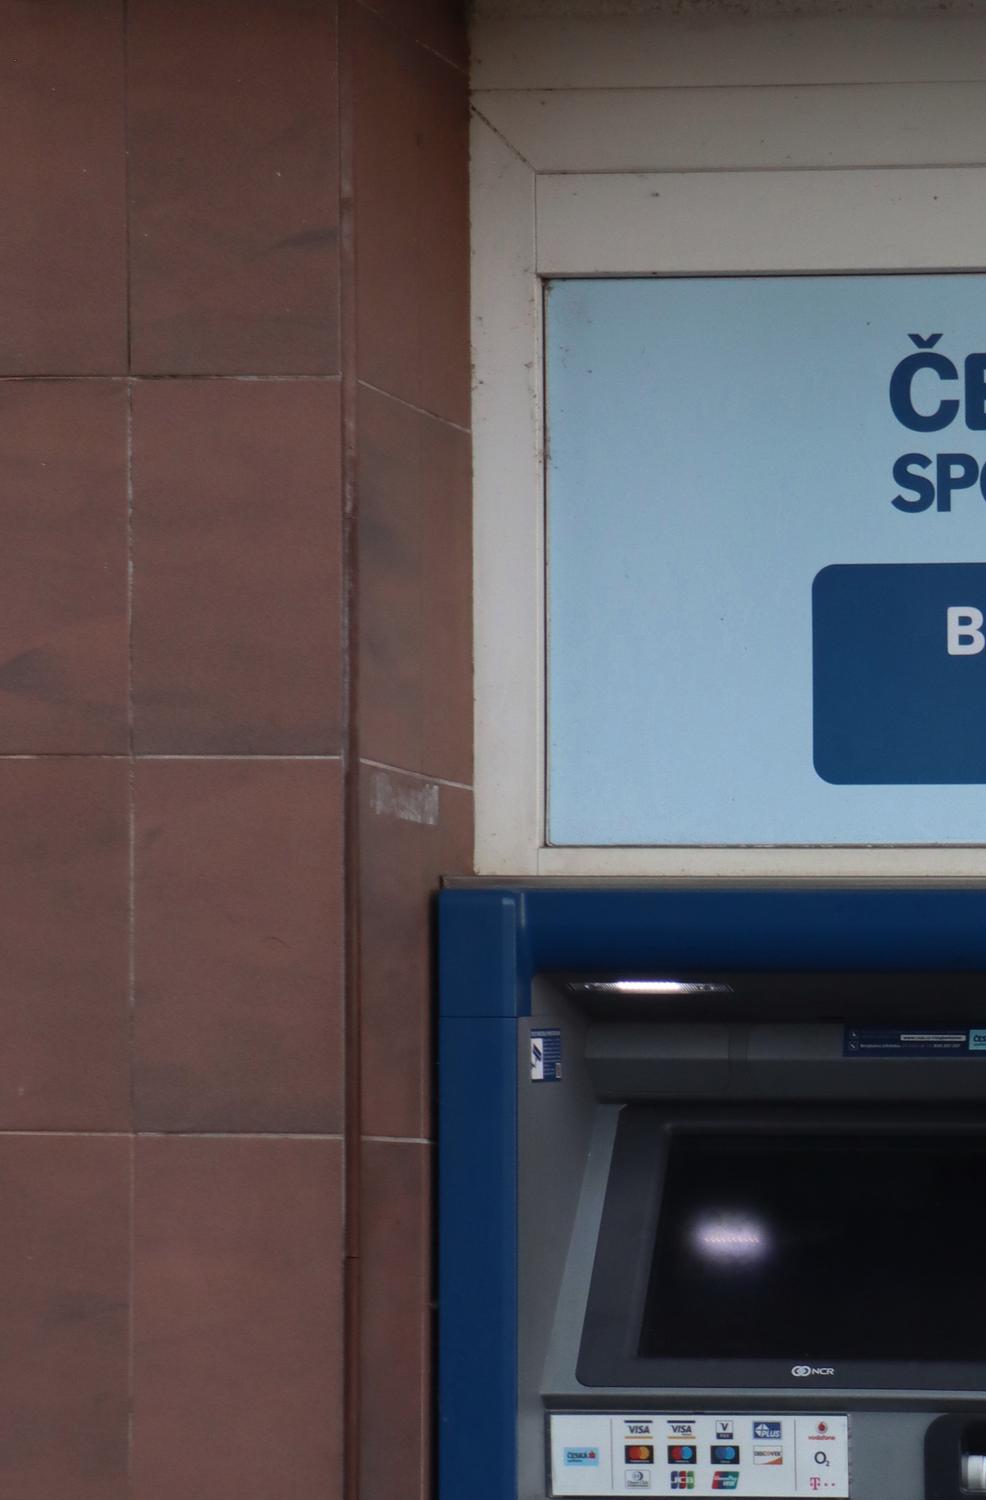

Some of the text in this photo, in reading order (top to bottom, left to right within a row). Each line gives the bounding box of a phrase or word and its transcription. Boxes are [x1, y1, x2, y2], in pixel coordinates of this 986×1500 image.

[811, 1367, 835, 1375] NCR
[628, 1425, 650, 1434] VISA
[671, 1424, 692, 1433] VISA
[762, 1430, 780, 1438] PLUS
